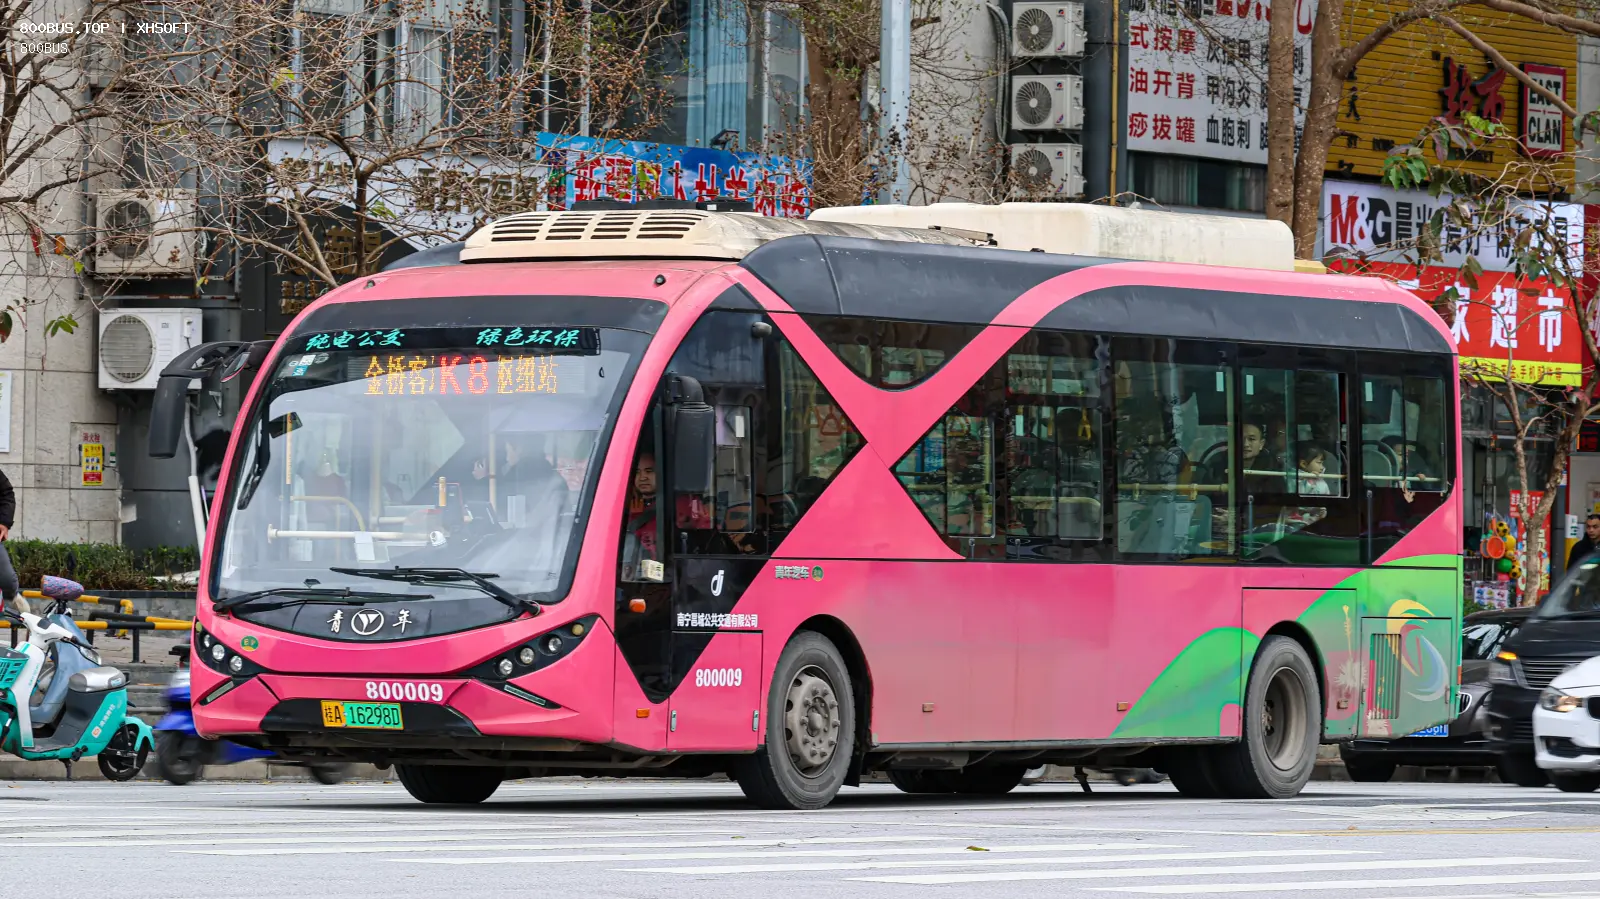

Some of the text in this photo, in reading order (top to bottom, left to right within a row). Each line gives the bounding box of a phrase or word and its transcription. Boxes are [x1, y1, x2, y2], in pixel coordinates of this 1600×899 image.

[1130, 23, 1197, 55] 式按摩
[1129, 67, 1196, 99] 油开背
[1529, 78, 1561, 106] EAST
[1129, 112, 1196, 143] 痧拔罐
[1528, 116, 1561, 145] CLAN
[1331, 194, 1391, 248] M&G
[1397, 279, 1563, 353] 家超市
[306, 327, 580, 351] 纯电公交 绿色环保
[440, 355, 488, 394] K8
[365, 681, 444, 702] 800009
[695, 668, 743, 687] 800009
[324, 704, 400, 726] 桂A 16298D
